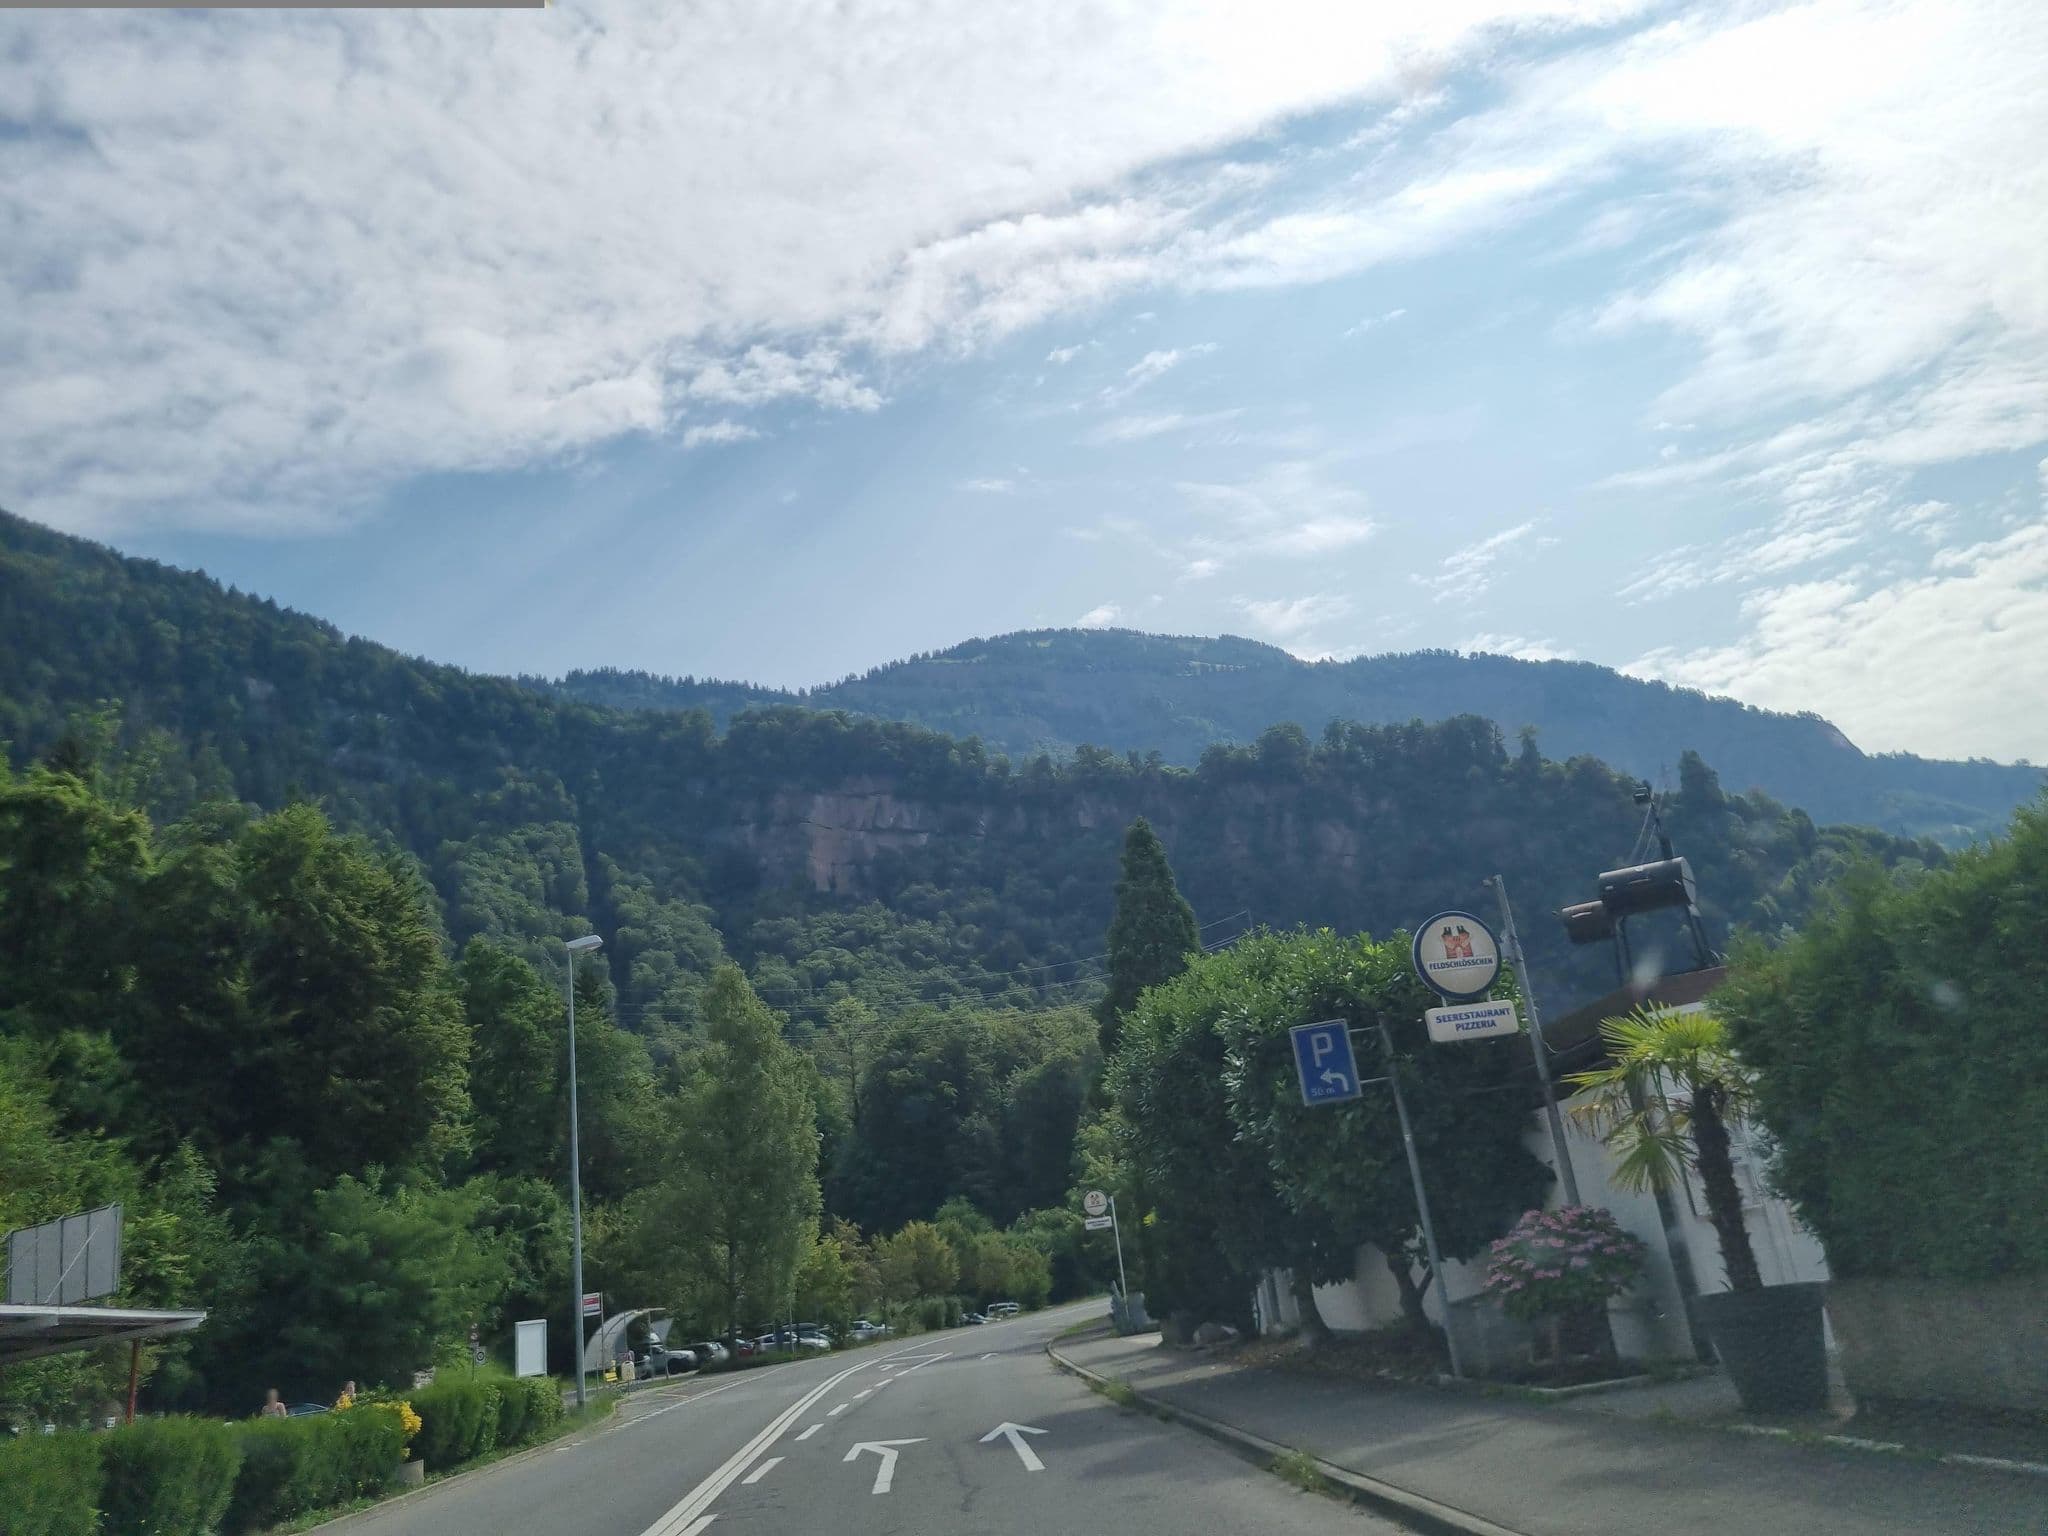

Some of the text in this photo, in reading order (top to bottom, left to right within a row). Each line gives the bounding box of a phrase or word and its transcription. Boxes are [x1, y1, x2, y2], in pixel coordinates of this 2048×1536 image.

[1429, 957, 1494, 970] FELDSCHLÖSSCHEN
[1435, 1007, 1511, 1024] SEERESTAURANT
[1455, 1020, 1497, 1032] PIZZERIA
[1311, 1032, 1333, 1068] P
